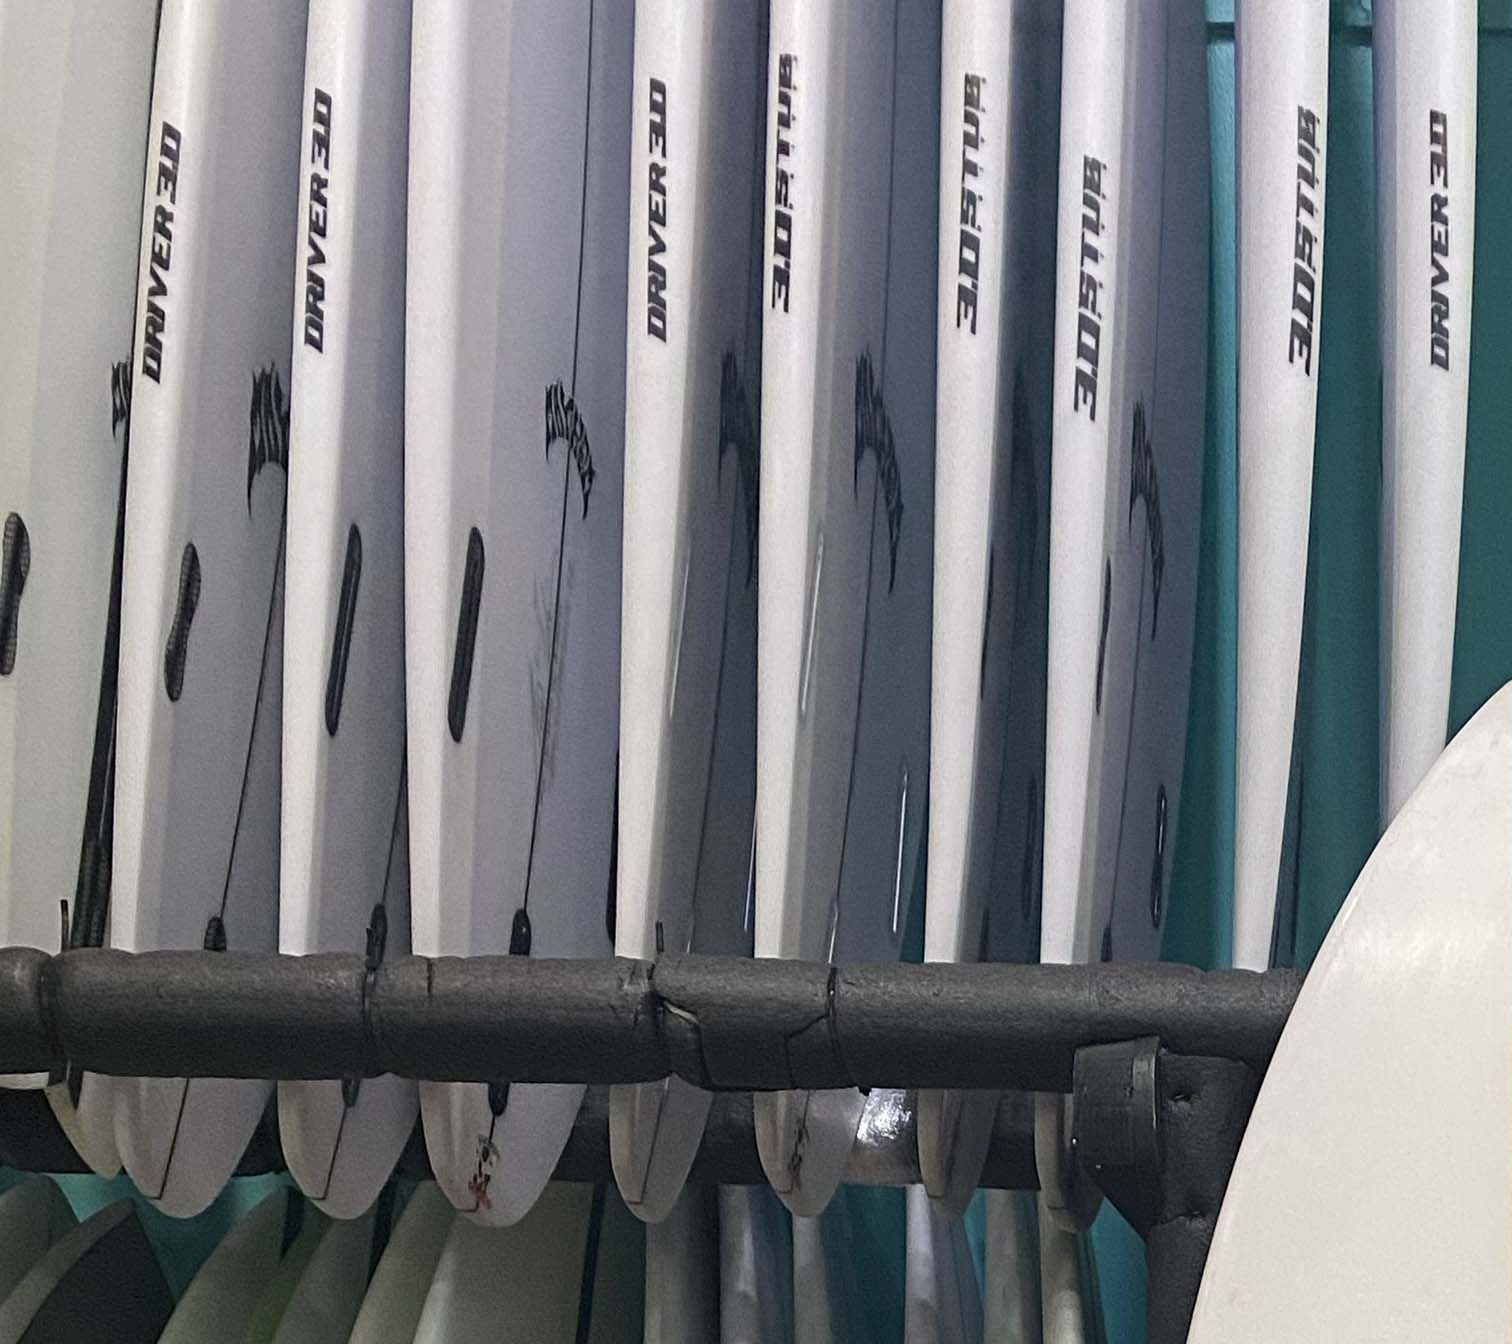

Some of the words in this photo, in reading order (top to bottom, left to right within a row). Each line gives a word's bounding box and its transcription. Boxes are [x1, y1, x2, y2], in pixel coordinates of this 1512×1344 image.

[142, 205, 174, 384] DRIVER
[304, 173, 328, 353] DRIVER
[647, 163, 667, 343] DRIVER
[1430, 194, 1449, 371] DRIVER
